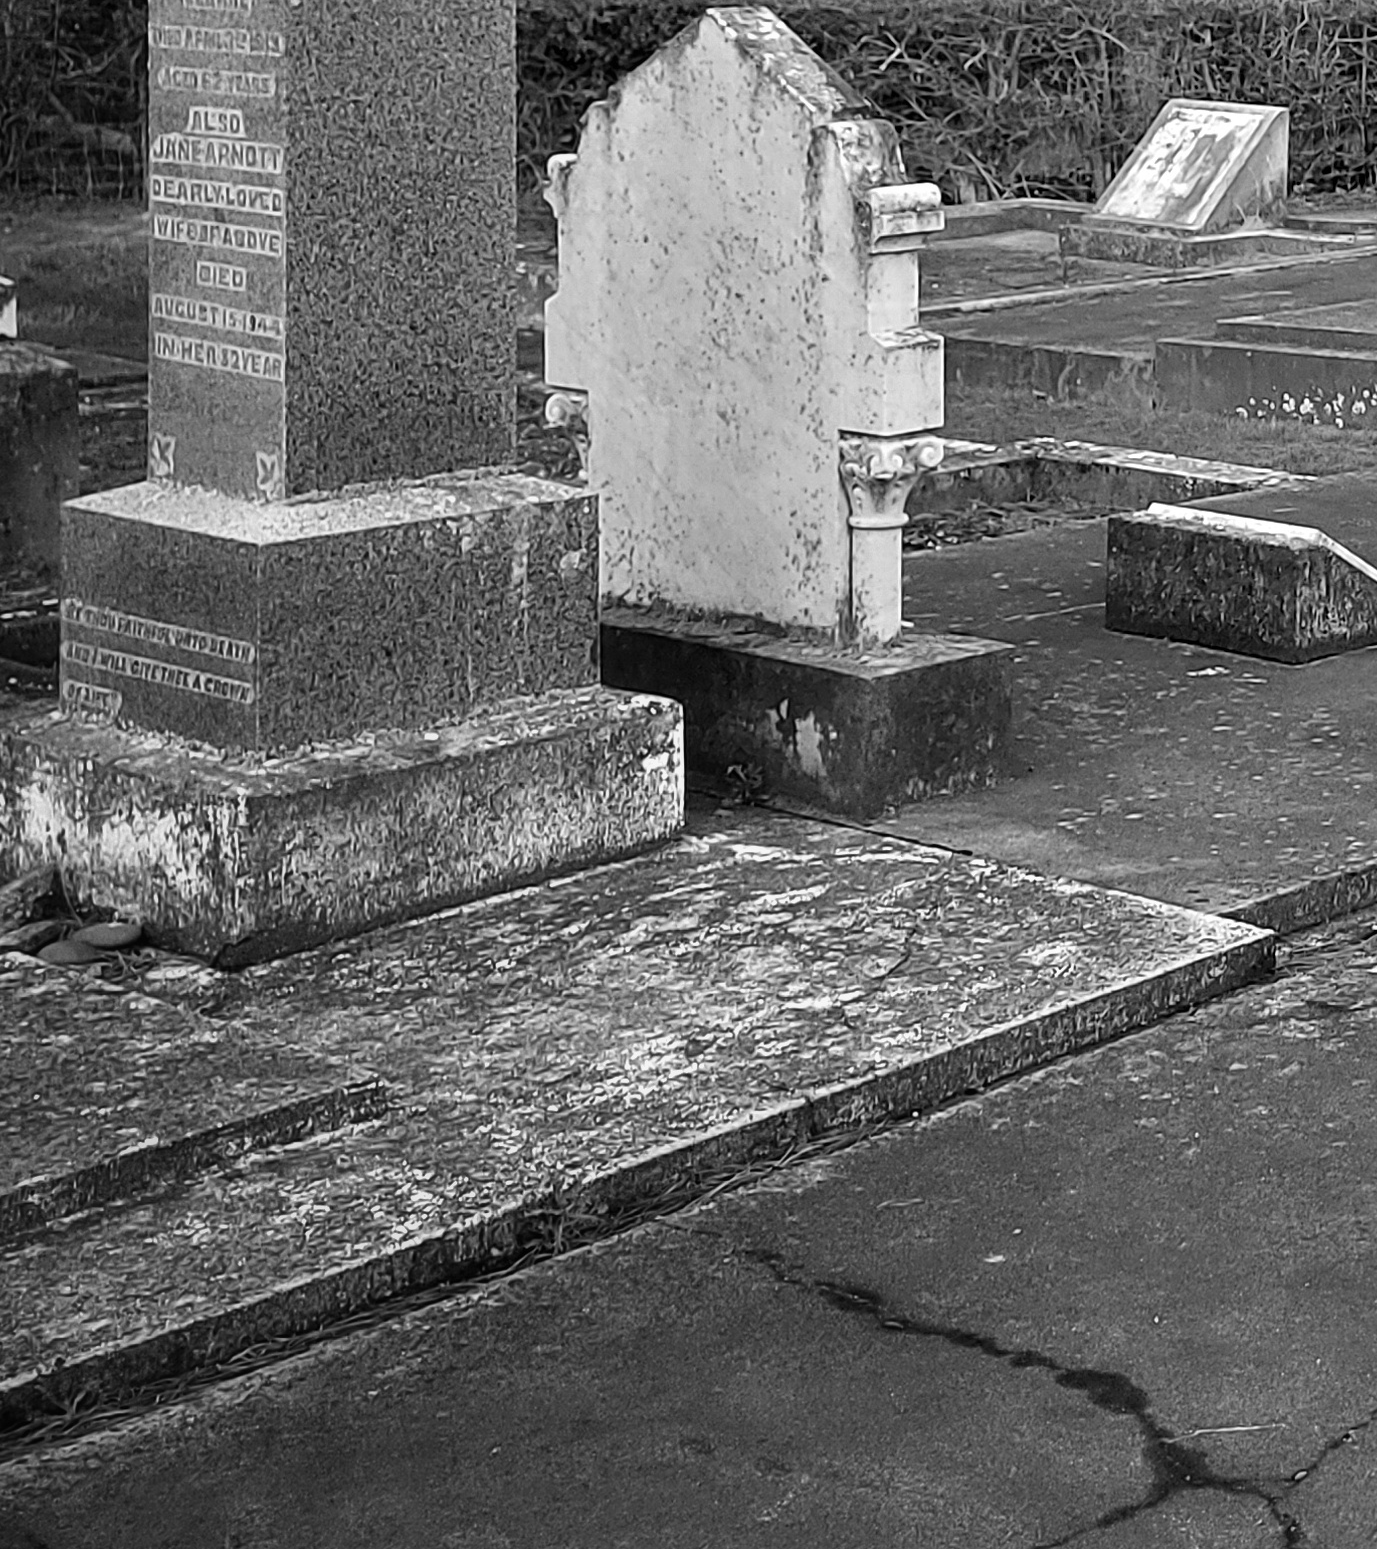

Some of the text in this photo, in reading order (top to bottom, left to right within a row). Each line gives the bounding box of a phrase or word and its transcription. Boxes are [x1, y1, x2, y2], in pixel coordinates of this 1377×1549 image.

[190, 109, 241, 134] ALSO
[153, 135, 200, 163] JANE
[225, 186, 282, 214] LOVED
[155, 216, 199, 241] WIFE
[222, 227, 281, 255] ABOVE
[200, 265, 245, 289] DIED
